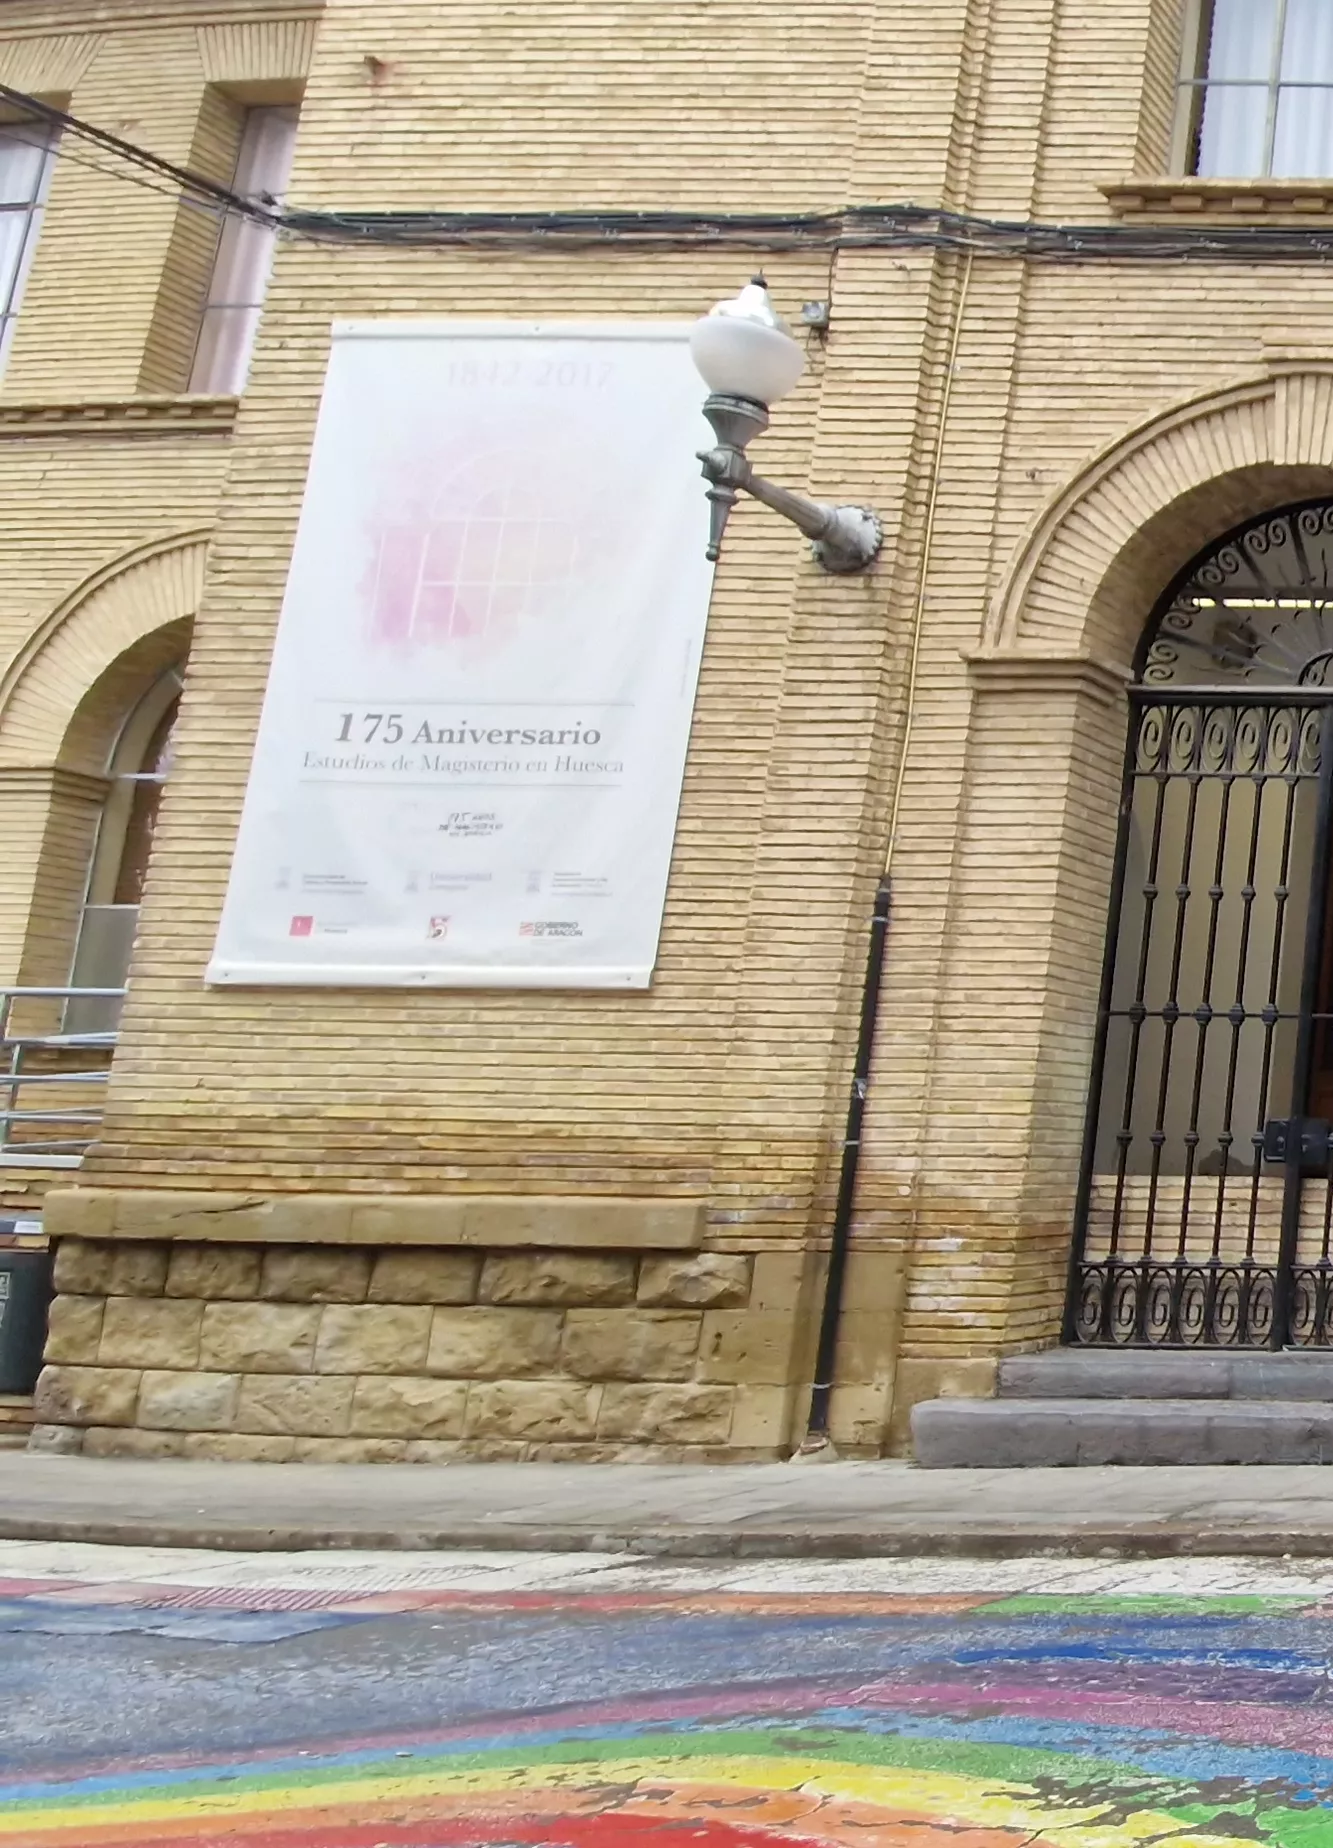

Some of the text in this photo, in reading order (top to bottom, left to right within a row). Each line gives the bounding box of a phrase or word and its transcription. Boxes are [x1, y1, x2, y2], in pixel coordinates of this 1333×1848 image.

[335, 711, 602, 746] 175 Aniversario
[303, 751, 624, 776] Estudios de Magisterio en Huesca
